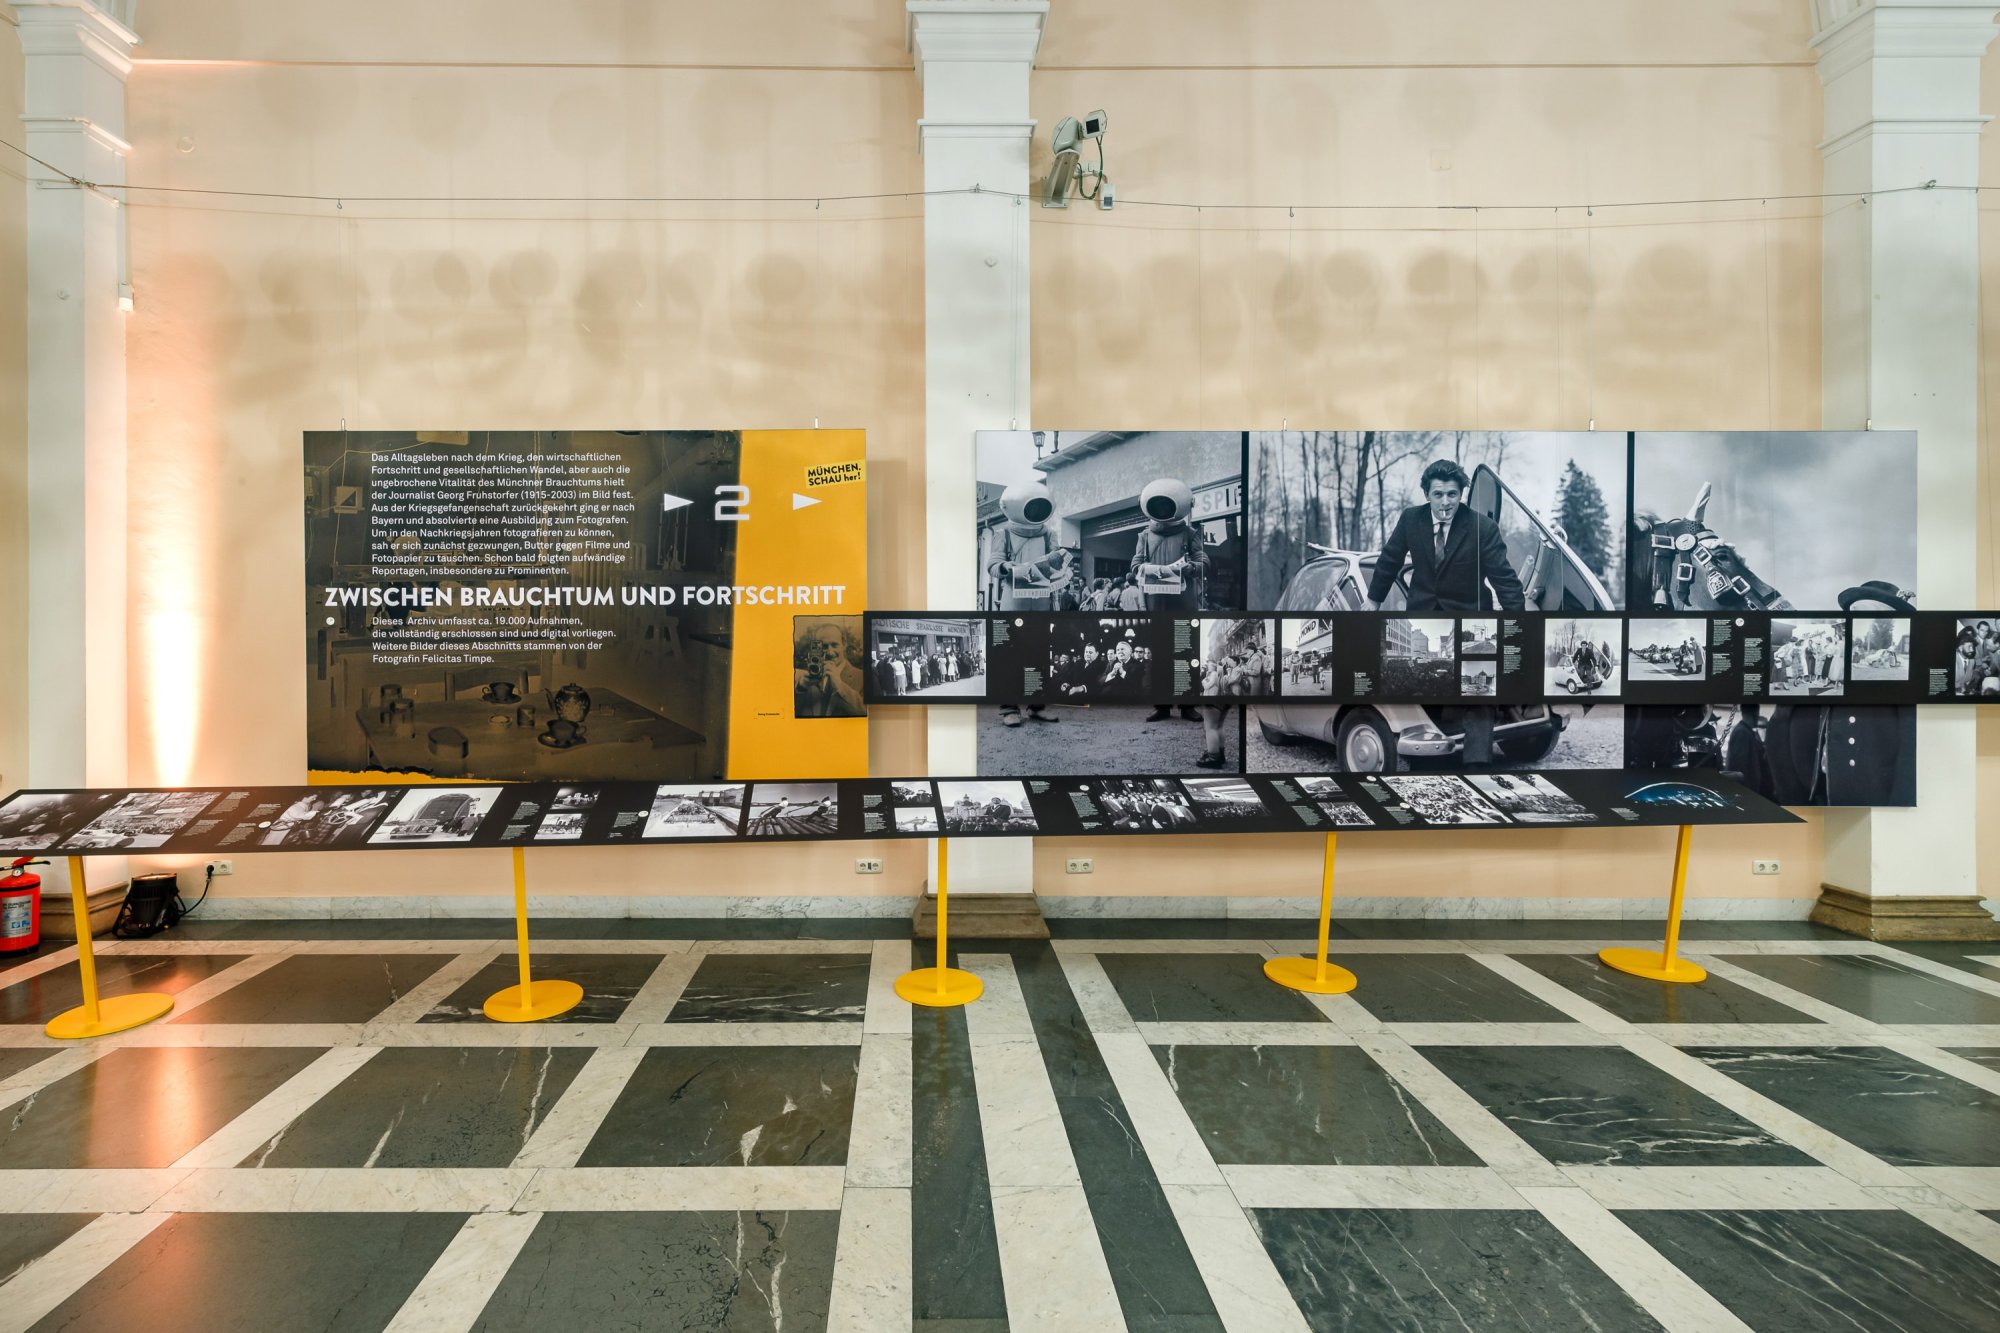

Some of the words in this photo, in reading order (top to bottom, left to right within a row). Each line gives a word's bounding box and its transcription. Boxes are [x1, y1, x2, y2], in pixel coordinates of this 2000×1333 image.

[371, 452, 390, 461] Das
[390, 452, 449, 463] Alltagsleben
[450, 452, 474, 461] nach
[475, 452, 496, 461] dem
[498, 452, 525, 463] Krieg,
[526, 452, 544, 461] den
[545, 452, 622, 461] wirtschaftlichen
[371, 465, 422, 474] Fortschritt
[423, 465, 441, 474] und
[442, 465, 528, 476] gesellschaftlichen
[529, 465, 567, 476] Wandel,
[568, 465, 590, 474] aber
[591, 465, 614, 474] auch
[615, 465, 631, 474] die
[807, 463, 861, 478] MÜNCHEN.
[371, 477, 438, 489] ungebrochene
[438, 477, 476, 487] Vitalität
[477, 477, 495, 487] des
[496, 477, 544, 487] Münchner
[545, 477, 602, 487] Brauchtums
[603, 477, 625, 487] hielt
[808, 474, 842, 486] SCHAU
[844, 472, 861, 482] her!
[371, 490, 388, 499] der
[388, 490, 436, 499] Journalist
[437, 490, 466, 501] Georg
[466, 490, 520, 499] Fruhstorfer
[520, 490, 578, 501] (1915-2003)
[578, 490, 591, 499] im
[592, 490, 611, 499] Bild
[612, 490, 634, 499] fest.
[714, 484, 750, 521] 2
[371, 503, 389, 512] Aus
[390, 503, 407, 512] der
[408, 503, 510, 514] Kriegsgefangenschaft
[511, 503, 578, 514] zurückgekehrt
[579, 503, 600, 514] ging
[600, 504, 611, 512] er
[612, 503, 635, 512] nach
[371, 515, 404, 526] Bayern
[405, 515, 424, 524] und
[425, 515, 478, 524] absolvierte
[479, 515, 500, 524] eine
[500, 515, 553, 526] Ausbildung
[576, 515, 629, 526] Fotografen.
[371, 528, 388, 537] Um
[389, 528, 398, 537] in
[400, 528, 418, 537] den
[419, 528, 501, 539] Nachkriegsjahren
[503, 528, 563, 539] fotografieren
[565, 529, 576, 537] zu
[578, 528, 615, 539] können,
[371, 540, 389, 549] sah
[401, 540, 422, 549] sich
[423, 540, 466, 549] zunächst
[467, 542, 523, 552] gezwungen,
[523, 540, 554, 549] Butter
[555, 542, 583, 552] gegen
[585, 540, 611, 549] Filme
[612, 540, 631, 549] und
[371, 553, 423, 564] Fotopapier
[436, 553, 483, 562] tauschen.
[484, 553, 514, 562] Schon
[515, 553, 536, 562] bald
[537, 553, 570, 564] folgten
[571, 553, 626, 564] aufwändige
[371, 566, 429, 577] Reportagen,
[429, 566, 493, 575] insbesondere
[494, 567, 506, 575] zu
[507, 566, 569, 575] Prominenten.
[324, 587, 453, 607] ZWISCHEN
[460, 587, 615, 606] BRAUCHTUM
[621, 586, 677, 606] UND
[683, 585, 846, 605] FORTSCHRITT
[372, 616, 404, 625] Dieses
[407, 616, 436, 625] Archiv
[438, 616, 476, 625] umfasst
[495, 616, 526, 625] 19.000
[527, 616, 583, 627] Aufnahmen,
[372, 629, 387, 637] die
[388, 629, 440, 640] vollständig
[441, 629, 497, 637] erschlossen
[499, 629, 519, 637] sind
[521, 629, 539, 637] und
[540, 629, 570, 640] digital
[571, 629, 616, 640] vorliegen.
[372, 641, 408, 650] Weitere
[409, 641, 438, 650] Bilder
[439, 641, 470, 650] dieses
[471, 641, 522, 650] Abschnitts
[523, 641, 567, 650] stammen
[586, 641, 603, 650] der
[372, 654, 420, 665] Fotografin
[422, 654, 462, 663] Felicitas
[463, 654, 495, 665] Timpe.
